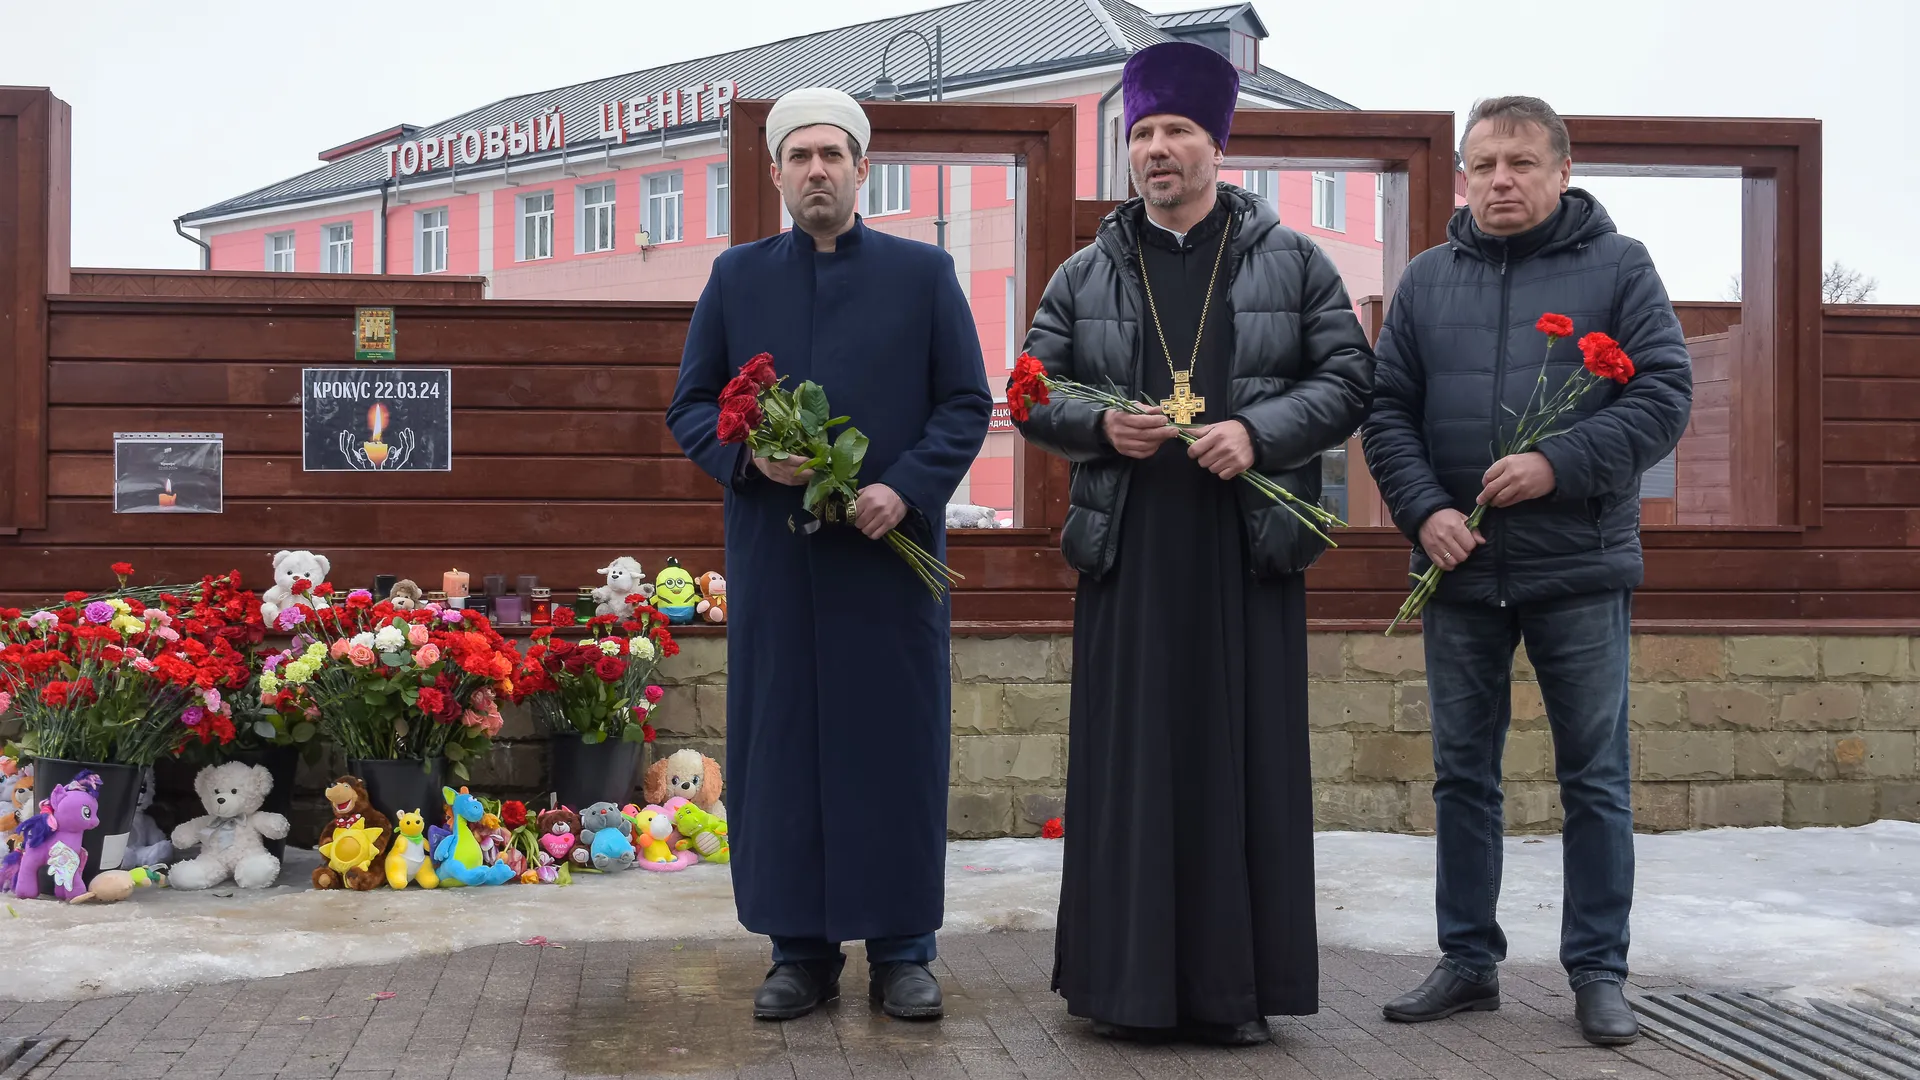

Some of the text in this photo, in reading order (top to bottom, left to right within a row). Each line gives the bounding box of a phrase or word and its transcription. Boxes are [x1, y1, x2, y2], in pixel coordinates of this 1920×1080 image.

[381, 79, 738, 178] ТОРГОВЫЙ ЦЕНТР
[313, 381, 440, 402] КРОКУС 22.03.24
